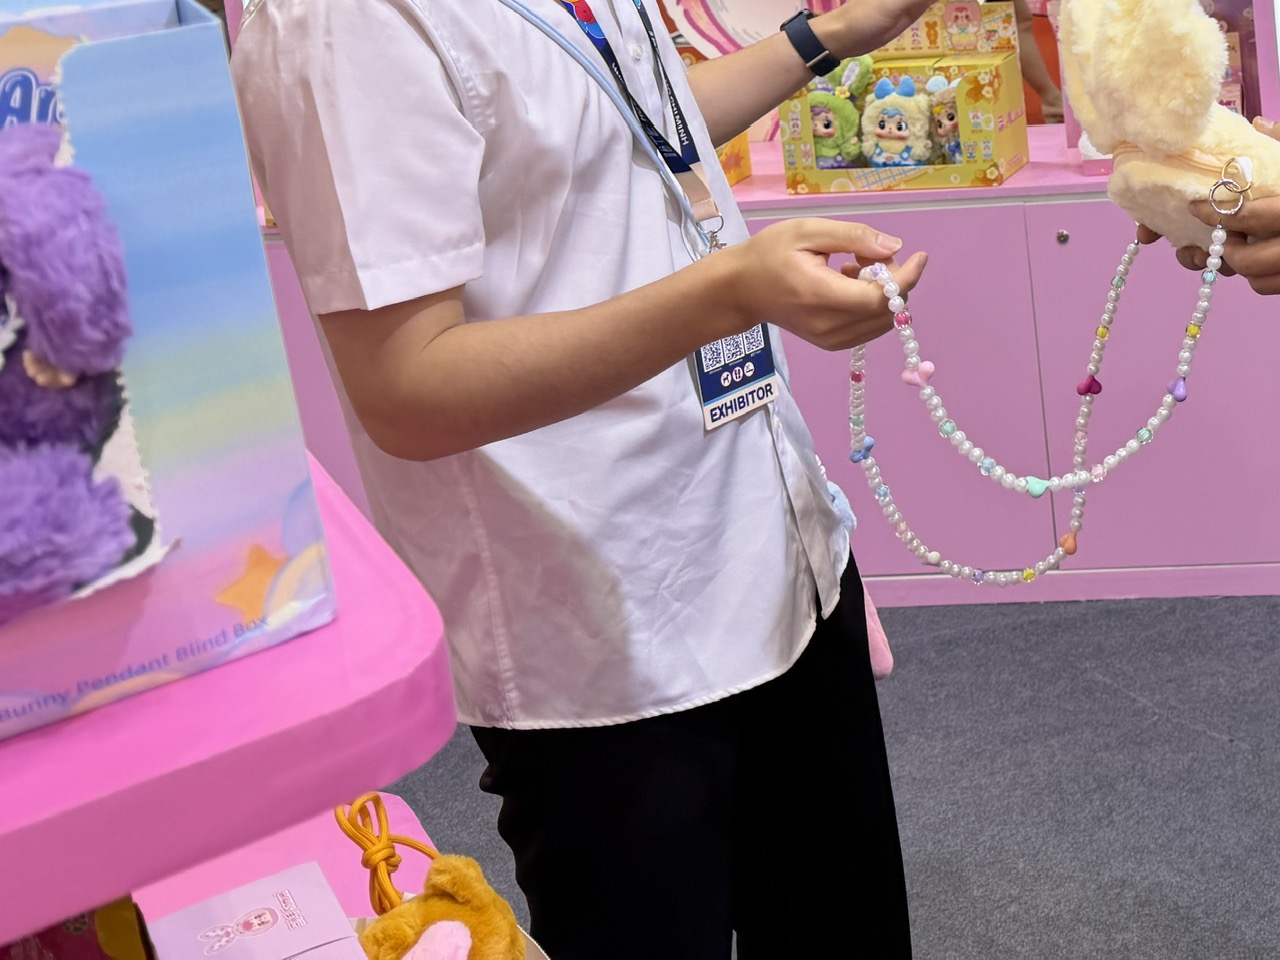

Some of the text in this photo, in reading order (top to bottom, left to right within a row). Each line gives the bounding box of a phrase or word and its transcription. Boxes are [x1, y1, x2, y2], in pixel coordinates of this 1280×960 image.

[674, 115, 690, 146] MINH
[709, 383, 774, 424] EXHIBITOR
[76, 653, 170, 696] Pendant
[176, 626, 228, 663] Blind
[233, 616, 270, 640] Box
